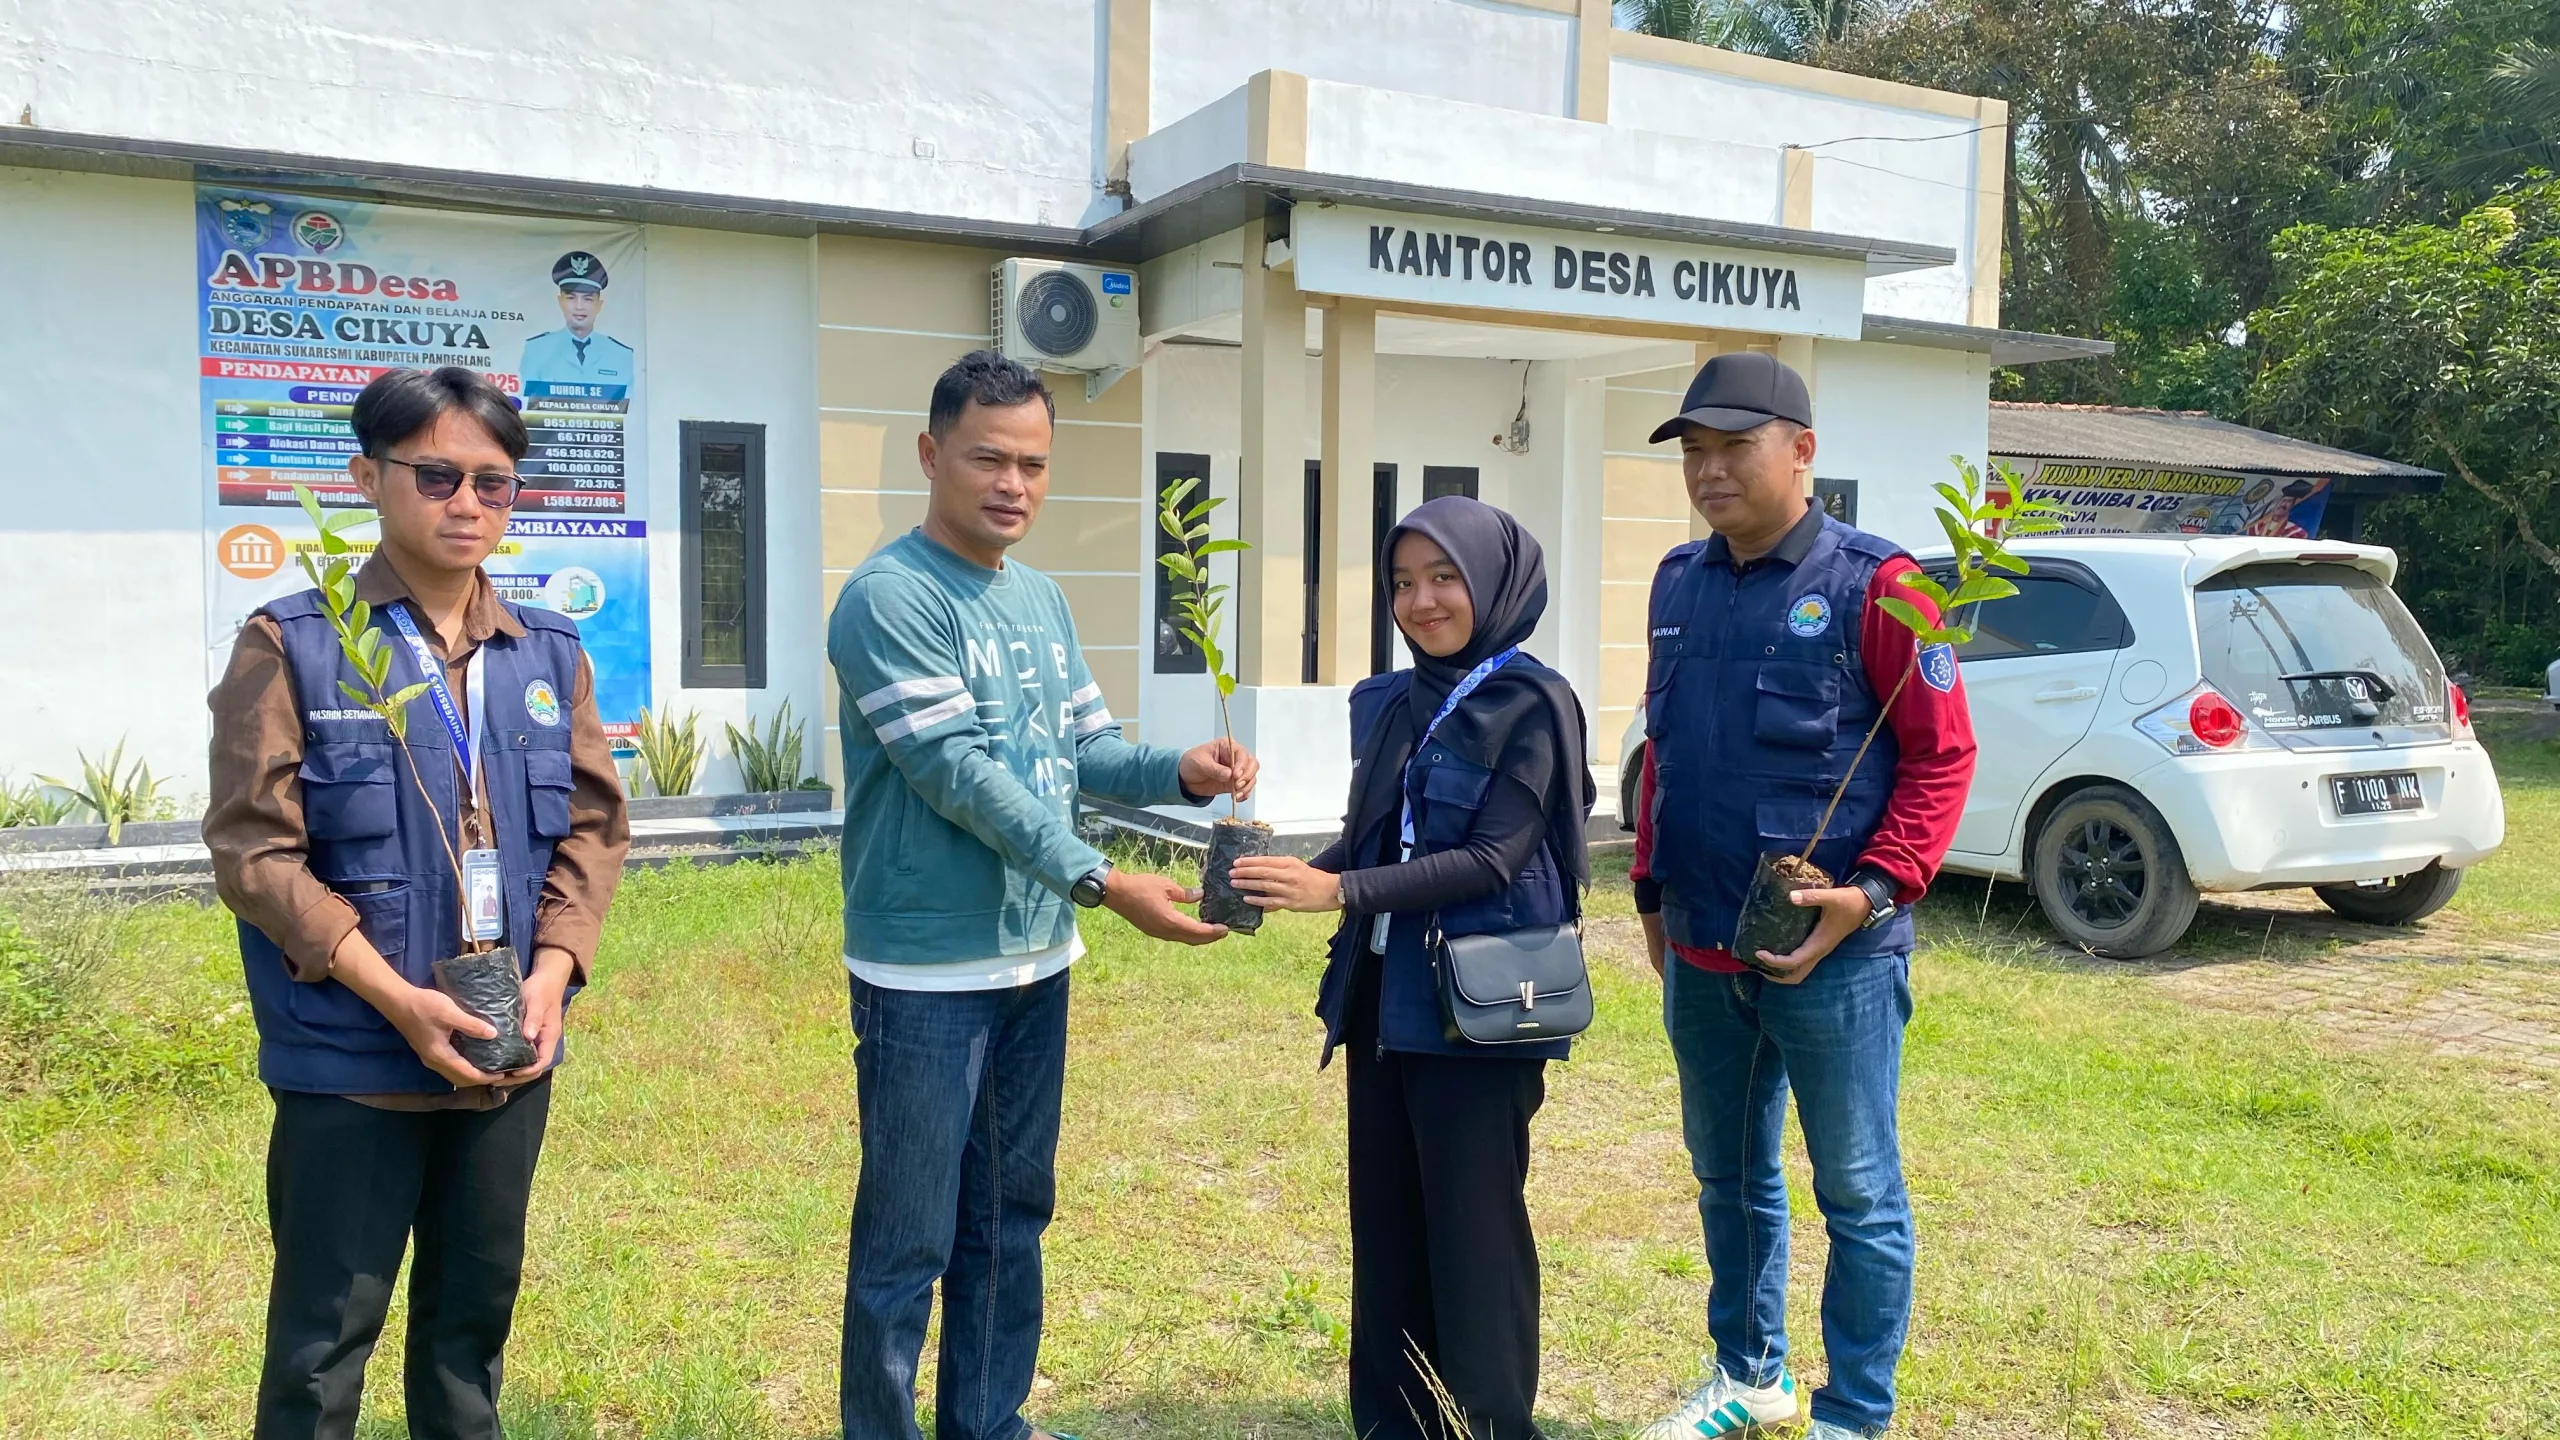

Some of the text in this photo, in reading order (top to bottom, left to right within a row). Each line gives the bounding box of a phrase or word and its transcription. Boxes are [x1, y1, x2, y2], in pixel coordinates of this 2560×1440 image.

[1370, 226, 1800, 310] KANTOR DESA CIKUYA
[212, 253, 459, 301] APBDesa
[211, 292, 524, 321] ANGGARAN PENDAPATAN DAN BELANJA DESA
[210, 308, 490, 349] DESA CIKUYA
[210, 341, 491, 367] KECAMATAN SUKARESMI KABUPATEN PANDEGLANG
[219, 361, 519, 393] PENDAPATAN 025
[590, 386, 602, 397] SE
[269, 406, 323, 418] Dana Desa
[539, 401, 569, 410] KEPALA
[570, 402, 591, 411] DESA
[269, 421, 350, 435] Bagi Hasil Pajak
[269, 438, 308, 449] Alokasi
[310, 440, 336, 450] Dana
[270, 454, 313, 465] Bantuan
[2033, 464, 2101, 487] KULIAH
[2095, 467, 2153, 489] KERJA
[2148, 470, 2245, 496] MAHASISWA
[313, 490, 366, 504] Pendapa
[2071, 491, 2136, 508] UNIBA
[2136, 495, 2184, 512] 2025
[505, 520, 628, 536] EMBIAYAAN
[2181, 515, 2208, 528] KKM
[517, 577, 539, 587] DESA
[309, 709, 341, 720] NASIHIN
[2309, 714, 2342, 726] AIRBUS
[2336, 776, 2419, 804] F 1100 NK
